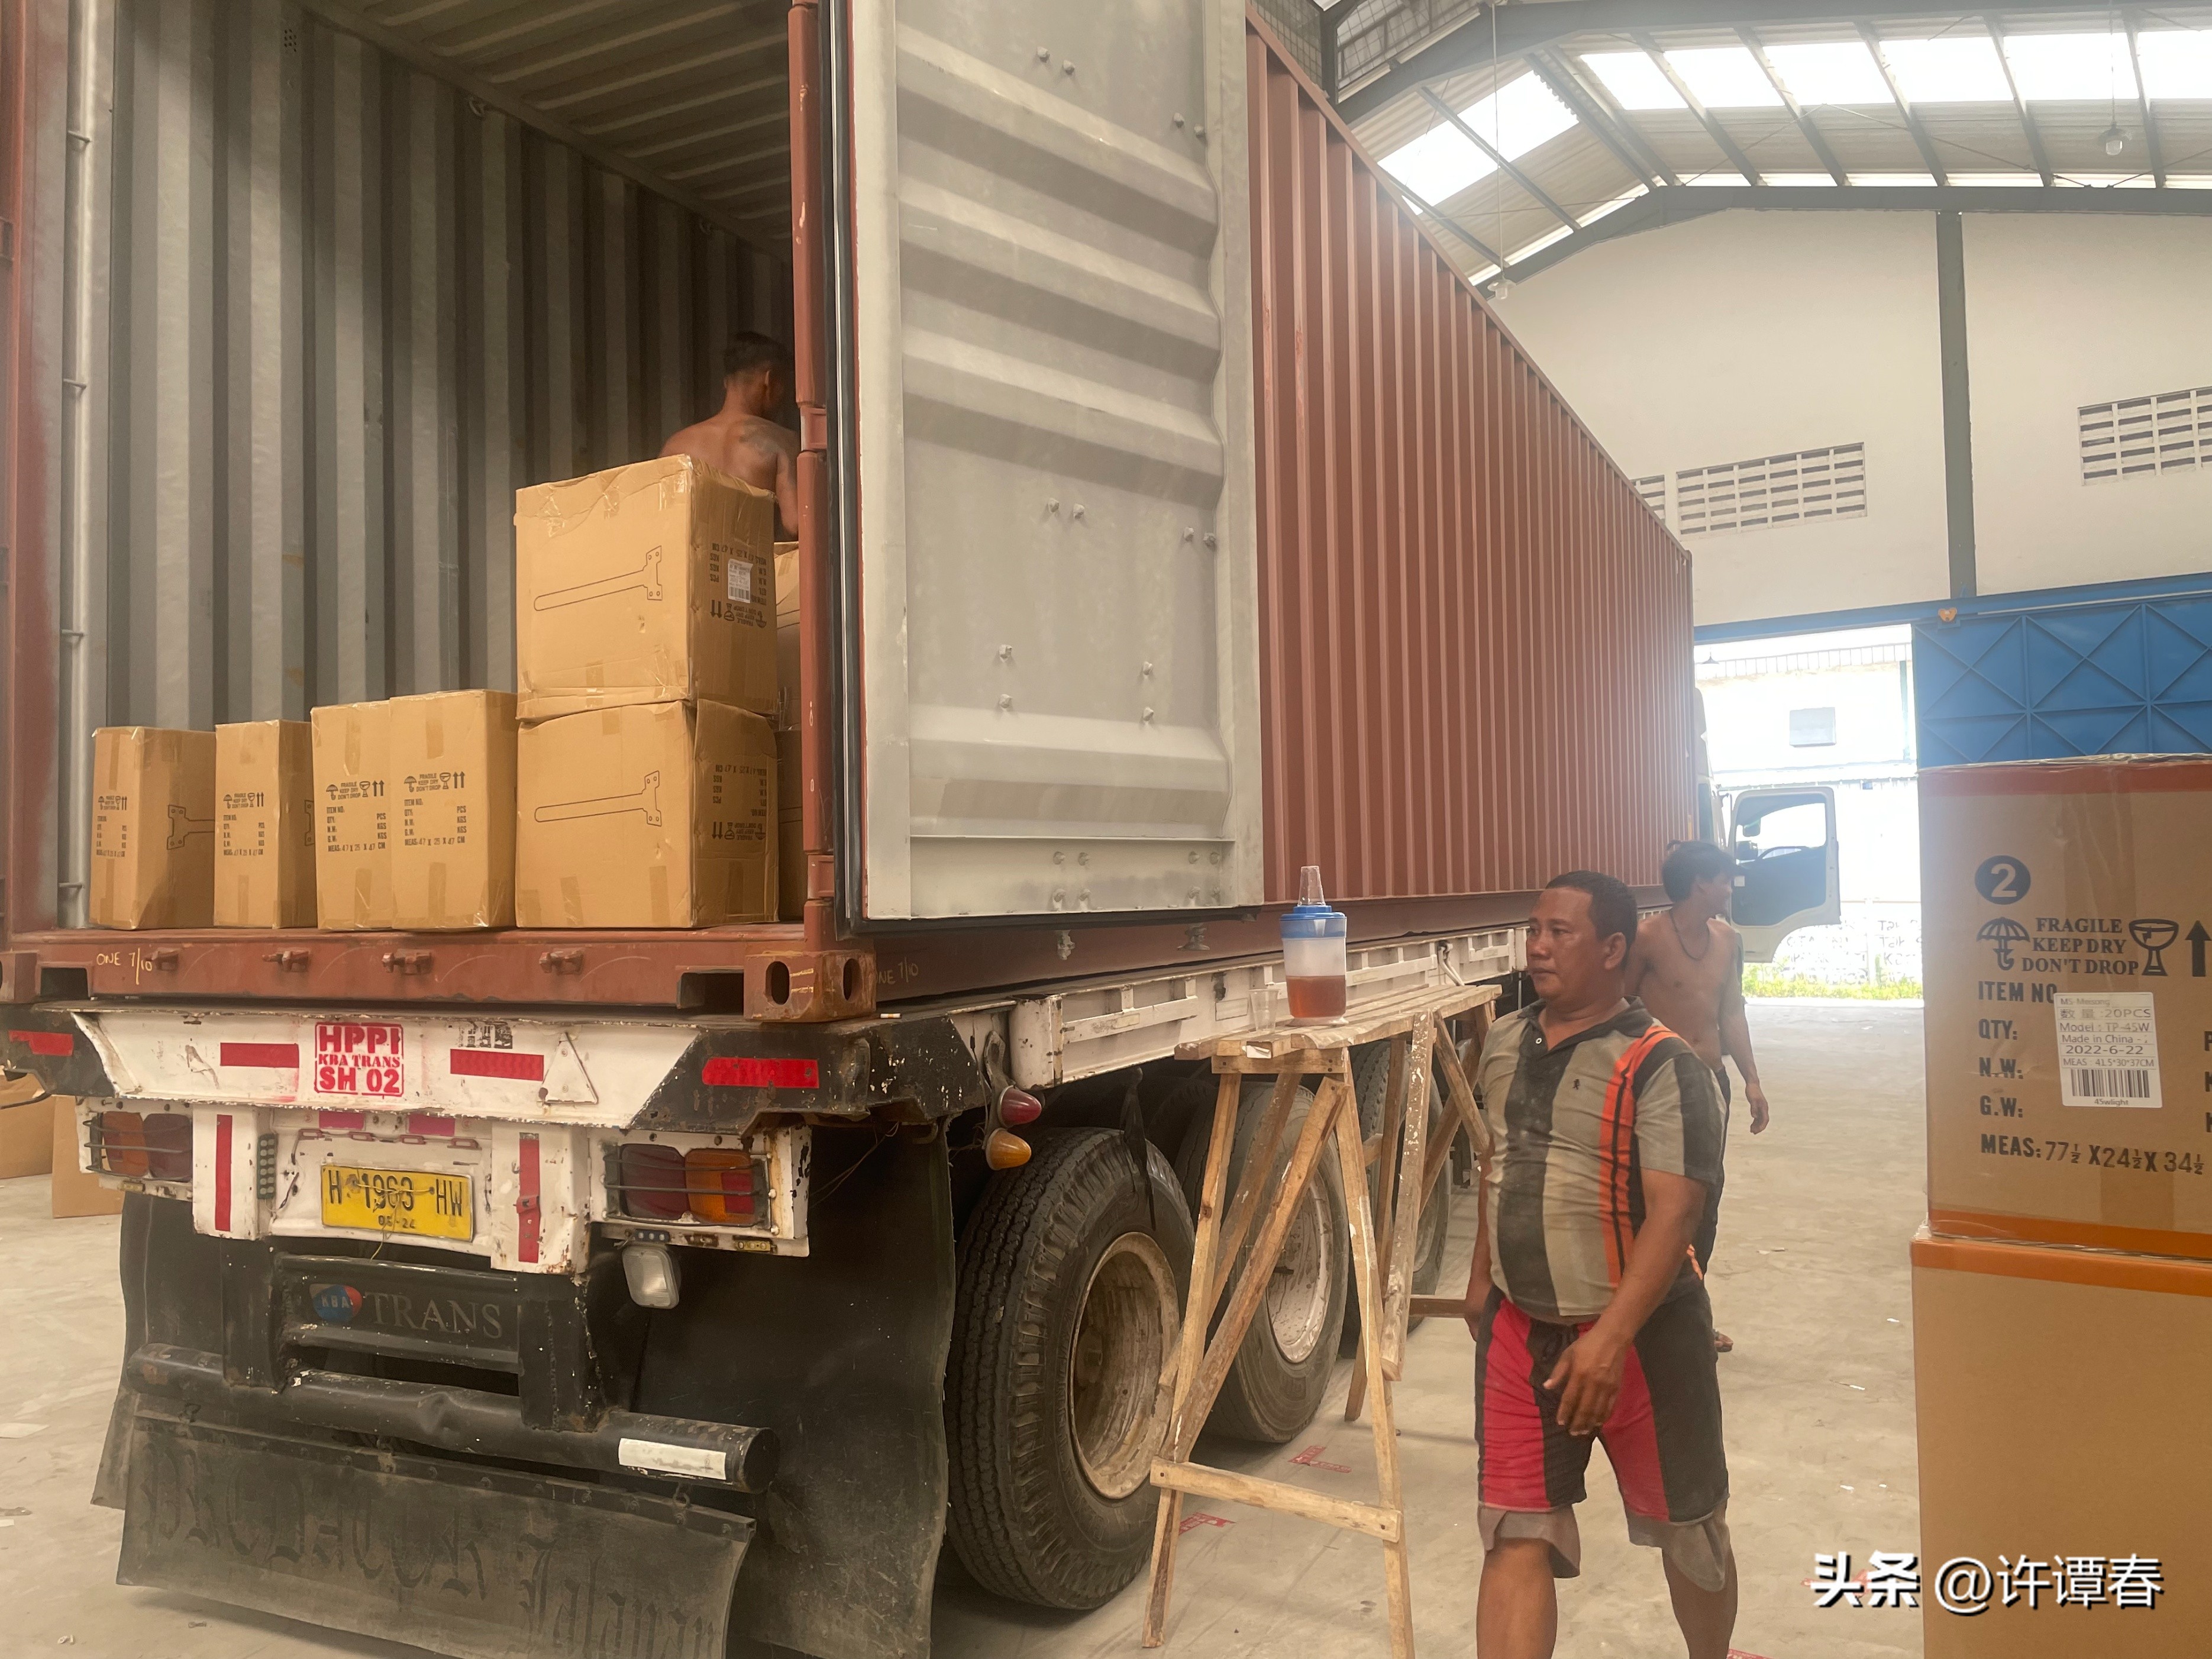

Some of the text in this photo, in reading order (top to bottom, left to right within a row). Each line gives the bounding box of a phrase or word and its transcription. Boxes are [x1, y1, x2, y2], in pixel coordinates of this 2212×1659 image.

[711, 574, 719, 582] PCS
[1991, 863, 2017, 898] 2
[2036, 918, 2122, 933] FRAGILE
[2033, 937, 2127, 954] KEEP DRY
[96, 952, 121, 966] ONE
[2022, 957, 2139, 976] DON'T DROP
[876, 970, 896, 985] NE
[1978, 981, 2023, 1002] ITEM
[1978, 1018, 2017, 1040] QTY:
[2060, 1022, 2094, 1031] Model
[2106, 1023, 2149, 1031] TP-45W
[319, 1025, 400, 1054] HPPI
[2106, 1035, 2133, 1043] China
[2066, 1045, 2143, 1054] 2022-6-22
[319, 1054, 401, 1068] KBA TRANS
[1979, 1057, 2023, 1079] N.W:
[319, 1067, 400, 1093] SH 02
[1980, 1095, 2023, 1118] G.W:
[1981, 1134, 2041, 1158] MEAS:
[328, 1170, 463, 1216] H 1963 HW
[321, 1292, 502, 1340] KBA TRANS
